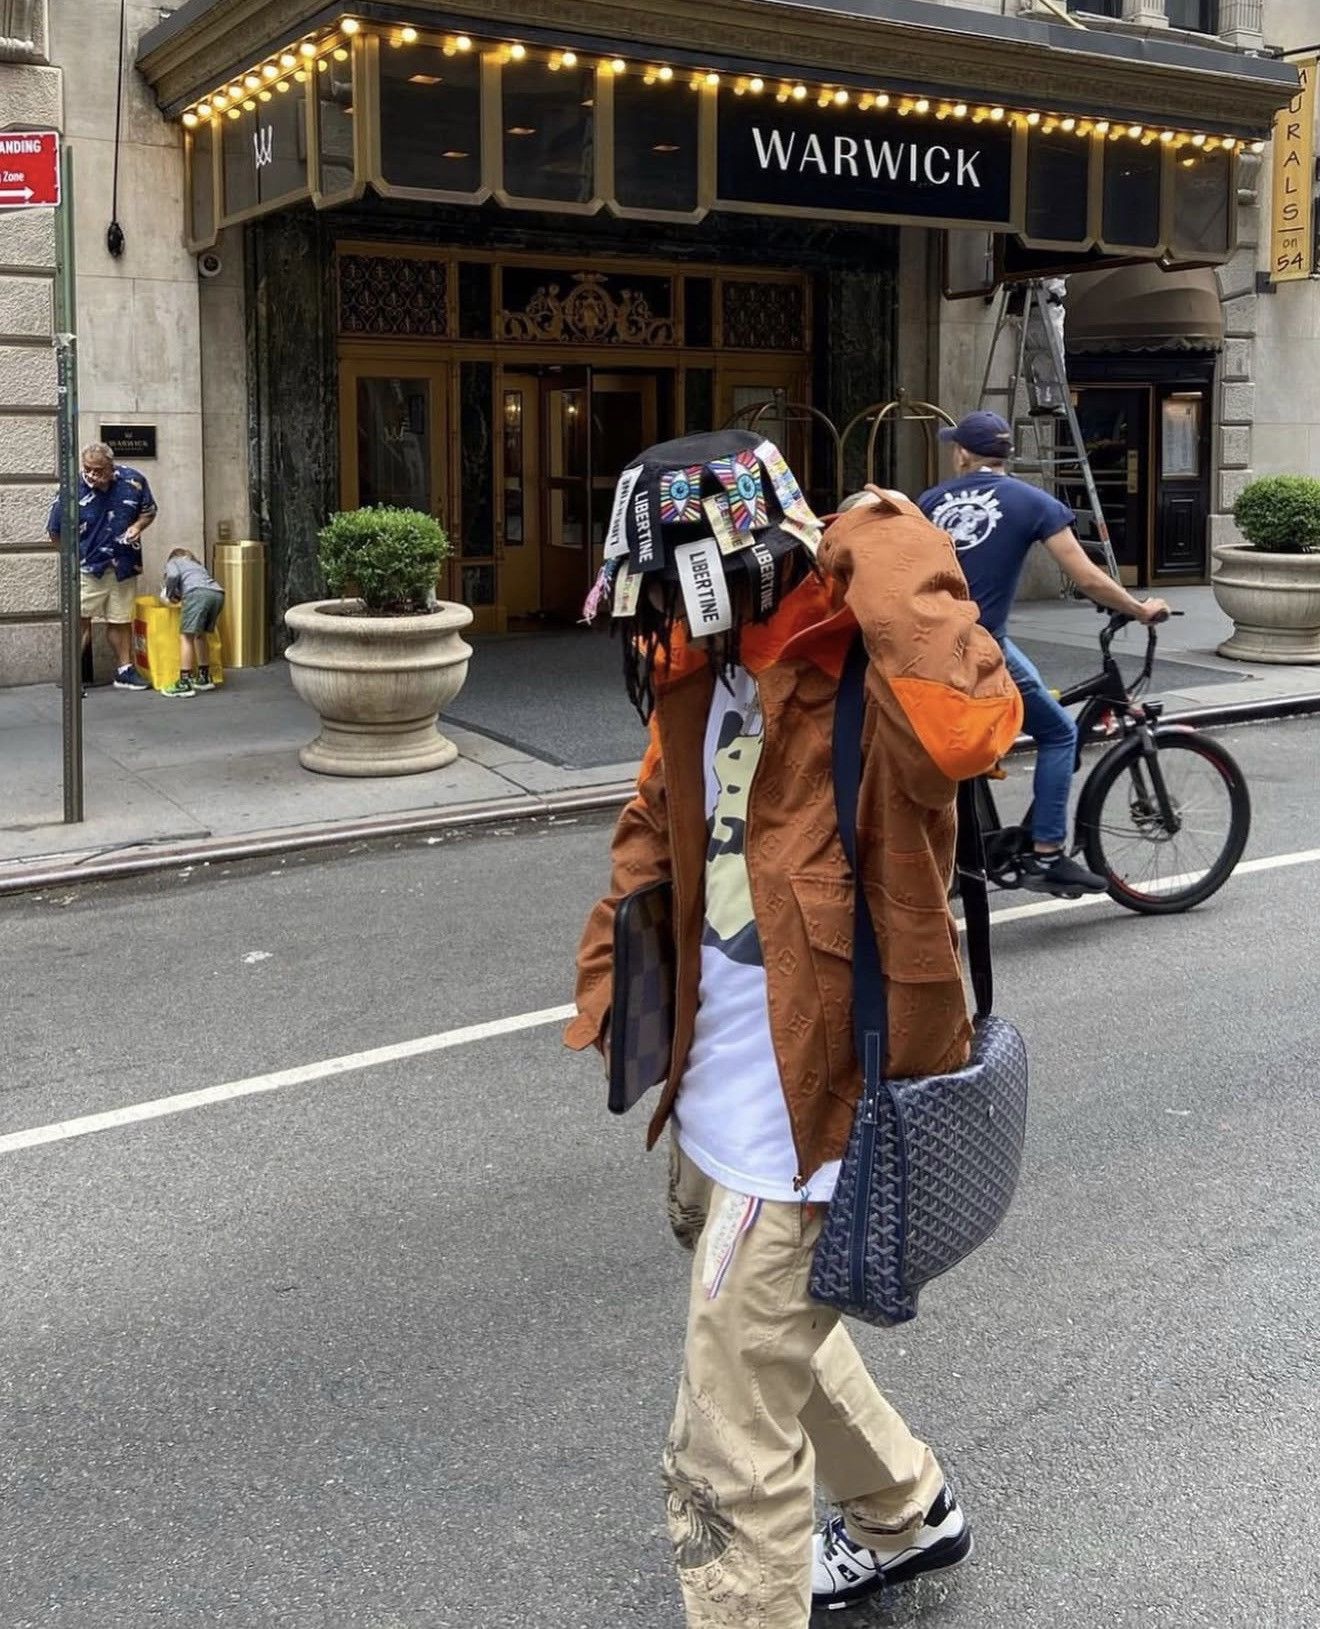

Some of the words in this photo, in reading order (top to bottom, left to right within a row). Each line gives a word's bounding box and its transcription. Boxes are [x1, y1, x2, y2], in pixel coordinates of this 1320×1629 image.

[3, 170, 25, 182] Zone
[751, 127, 981, 188] WARWICK
[1277, 252, 1304, 272] 54
[1282, 238, 1298, 248] on
[634, 490, 654, 563] LIBERTINE
[689, 550, 720, 623] LIBERTINE
[751, 543, 775, 613] LIBERTINE
